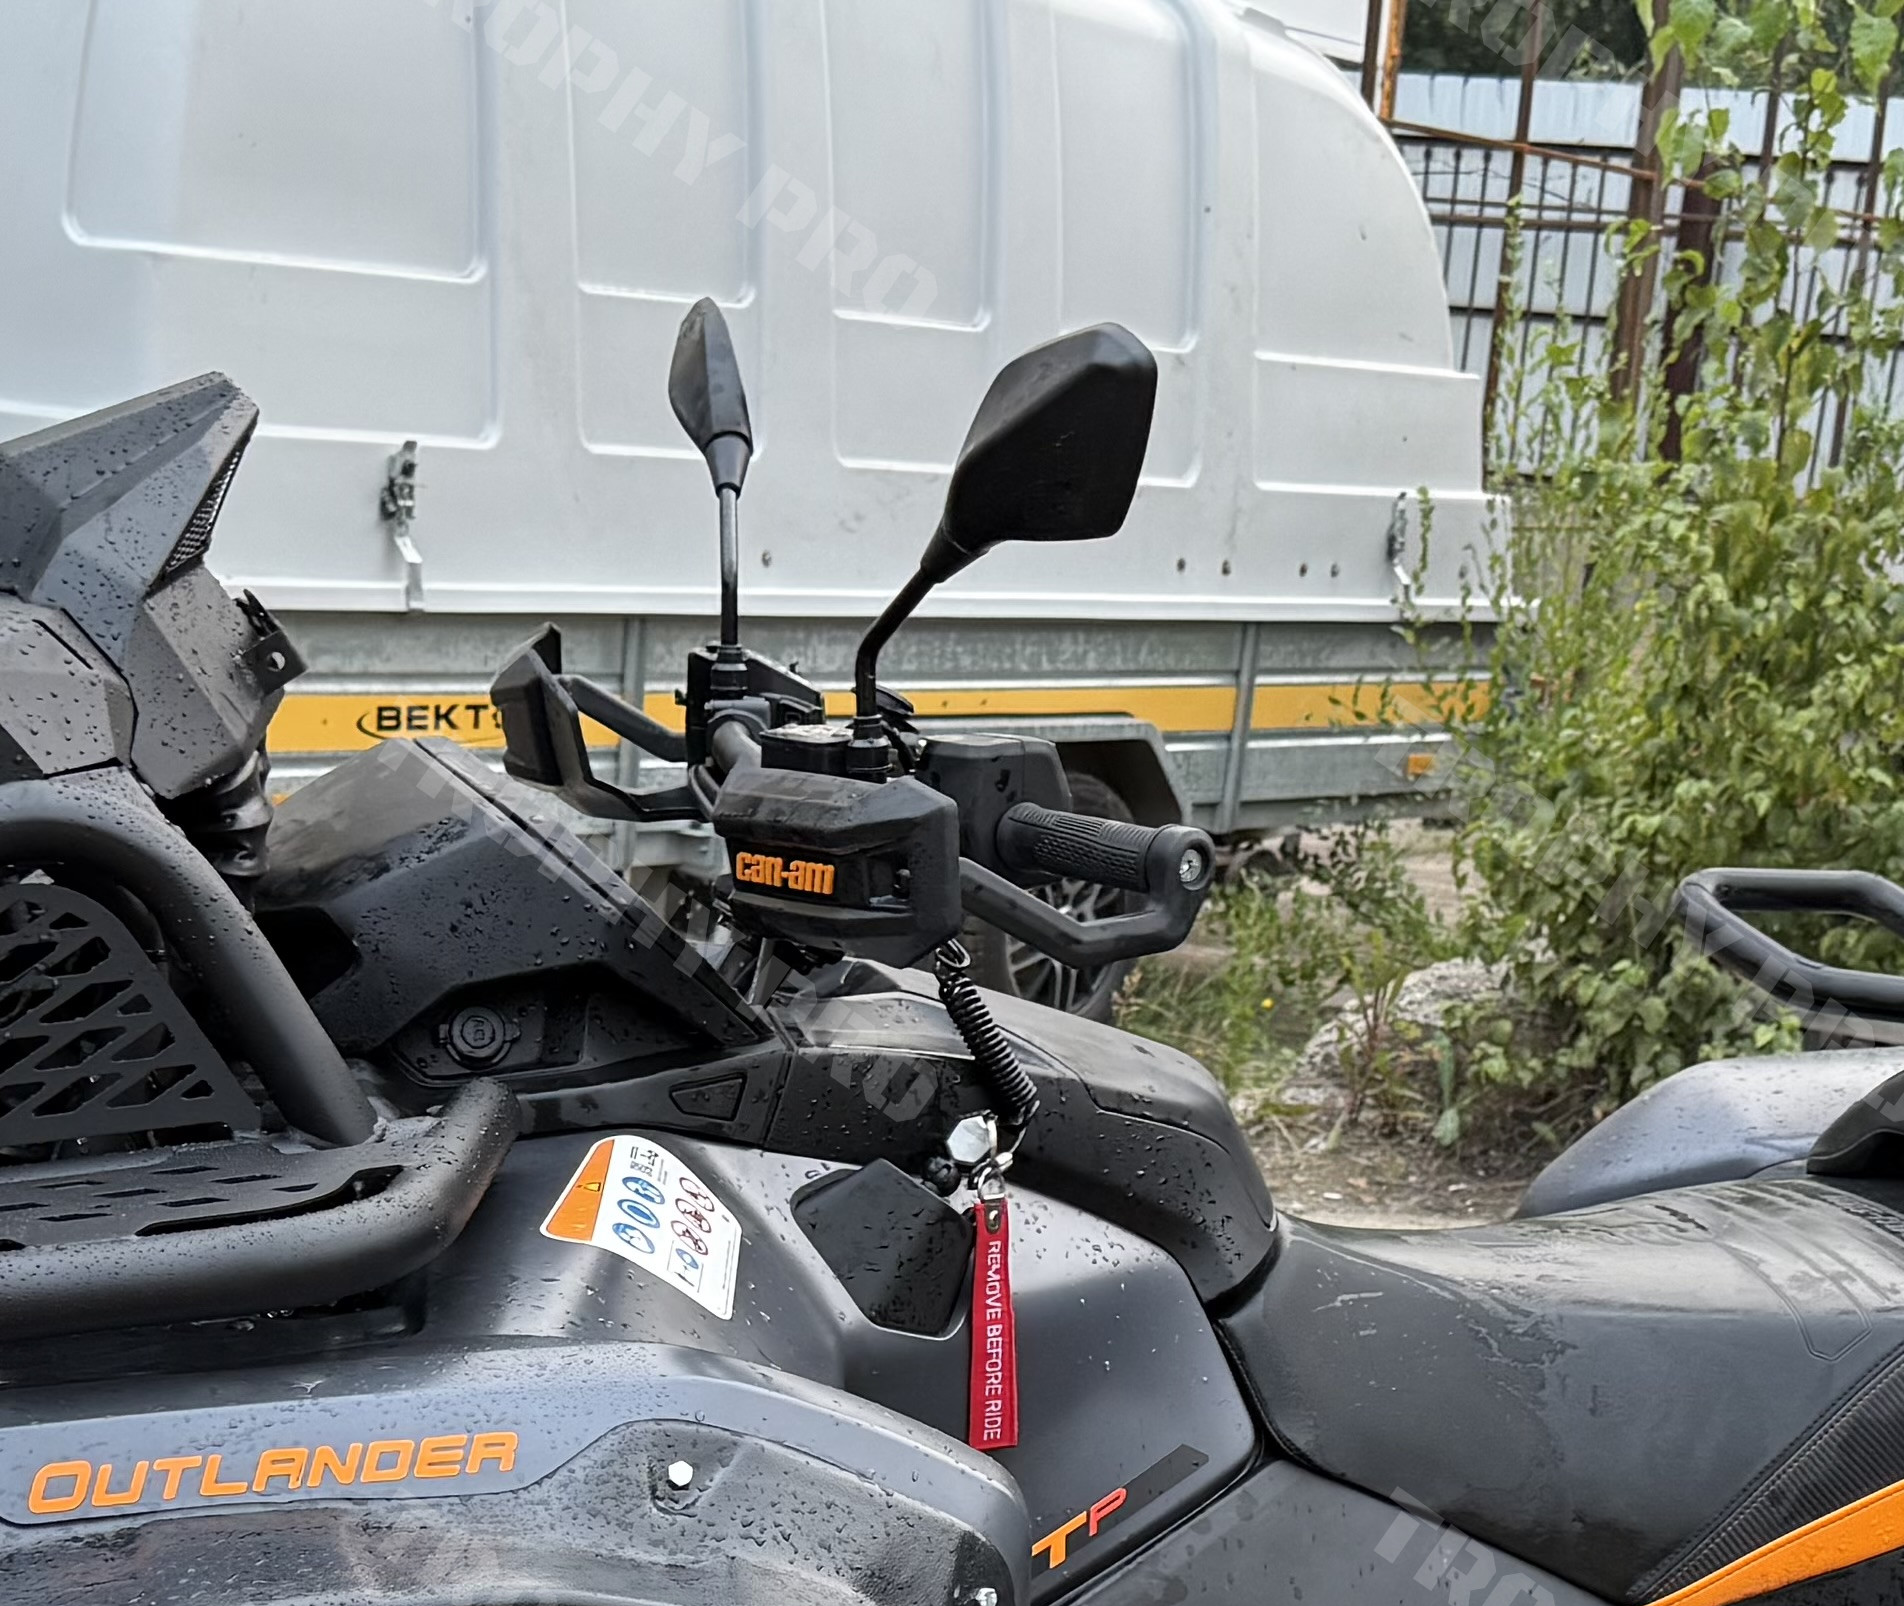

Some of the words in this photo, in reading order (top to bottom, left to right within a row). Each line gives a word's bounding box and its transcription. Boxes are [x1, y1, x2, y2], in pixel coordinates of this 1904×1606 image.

[377, 704, 502, 731] ВЕКТ
[736, 852, 835, 895] can-am
[985, 1240, 1003, 1321] REMOVE
[984, 1324, 1004, 1396] BEFORE
[983, 1400, 1004, 1441] RIDE
[28, 1431, 519, 1514] OUTLANDER
